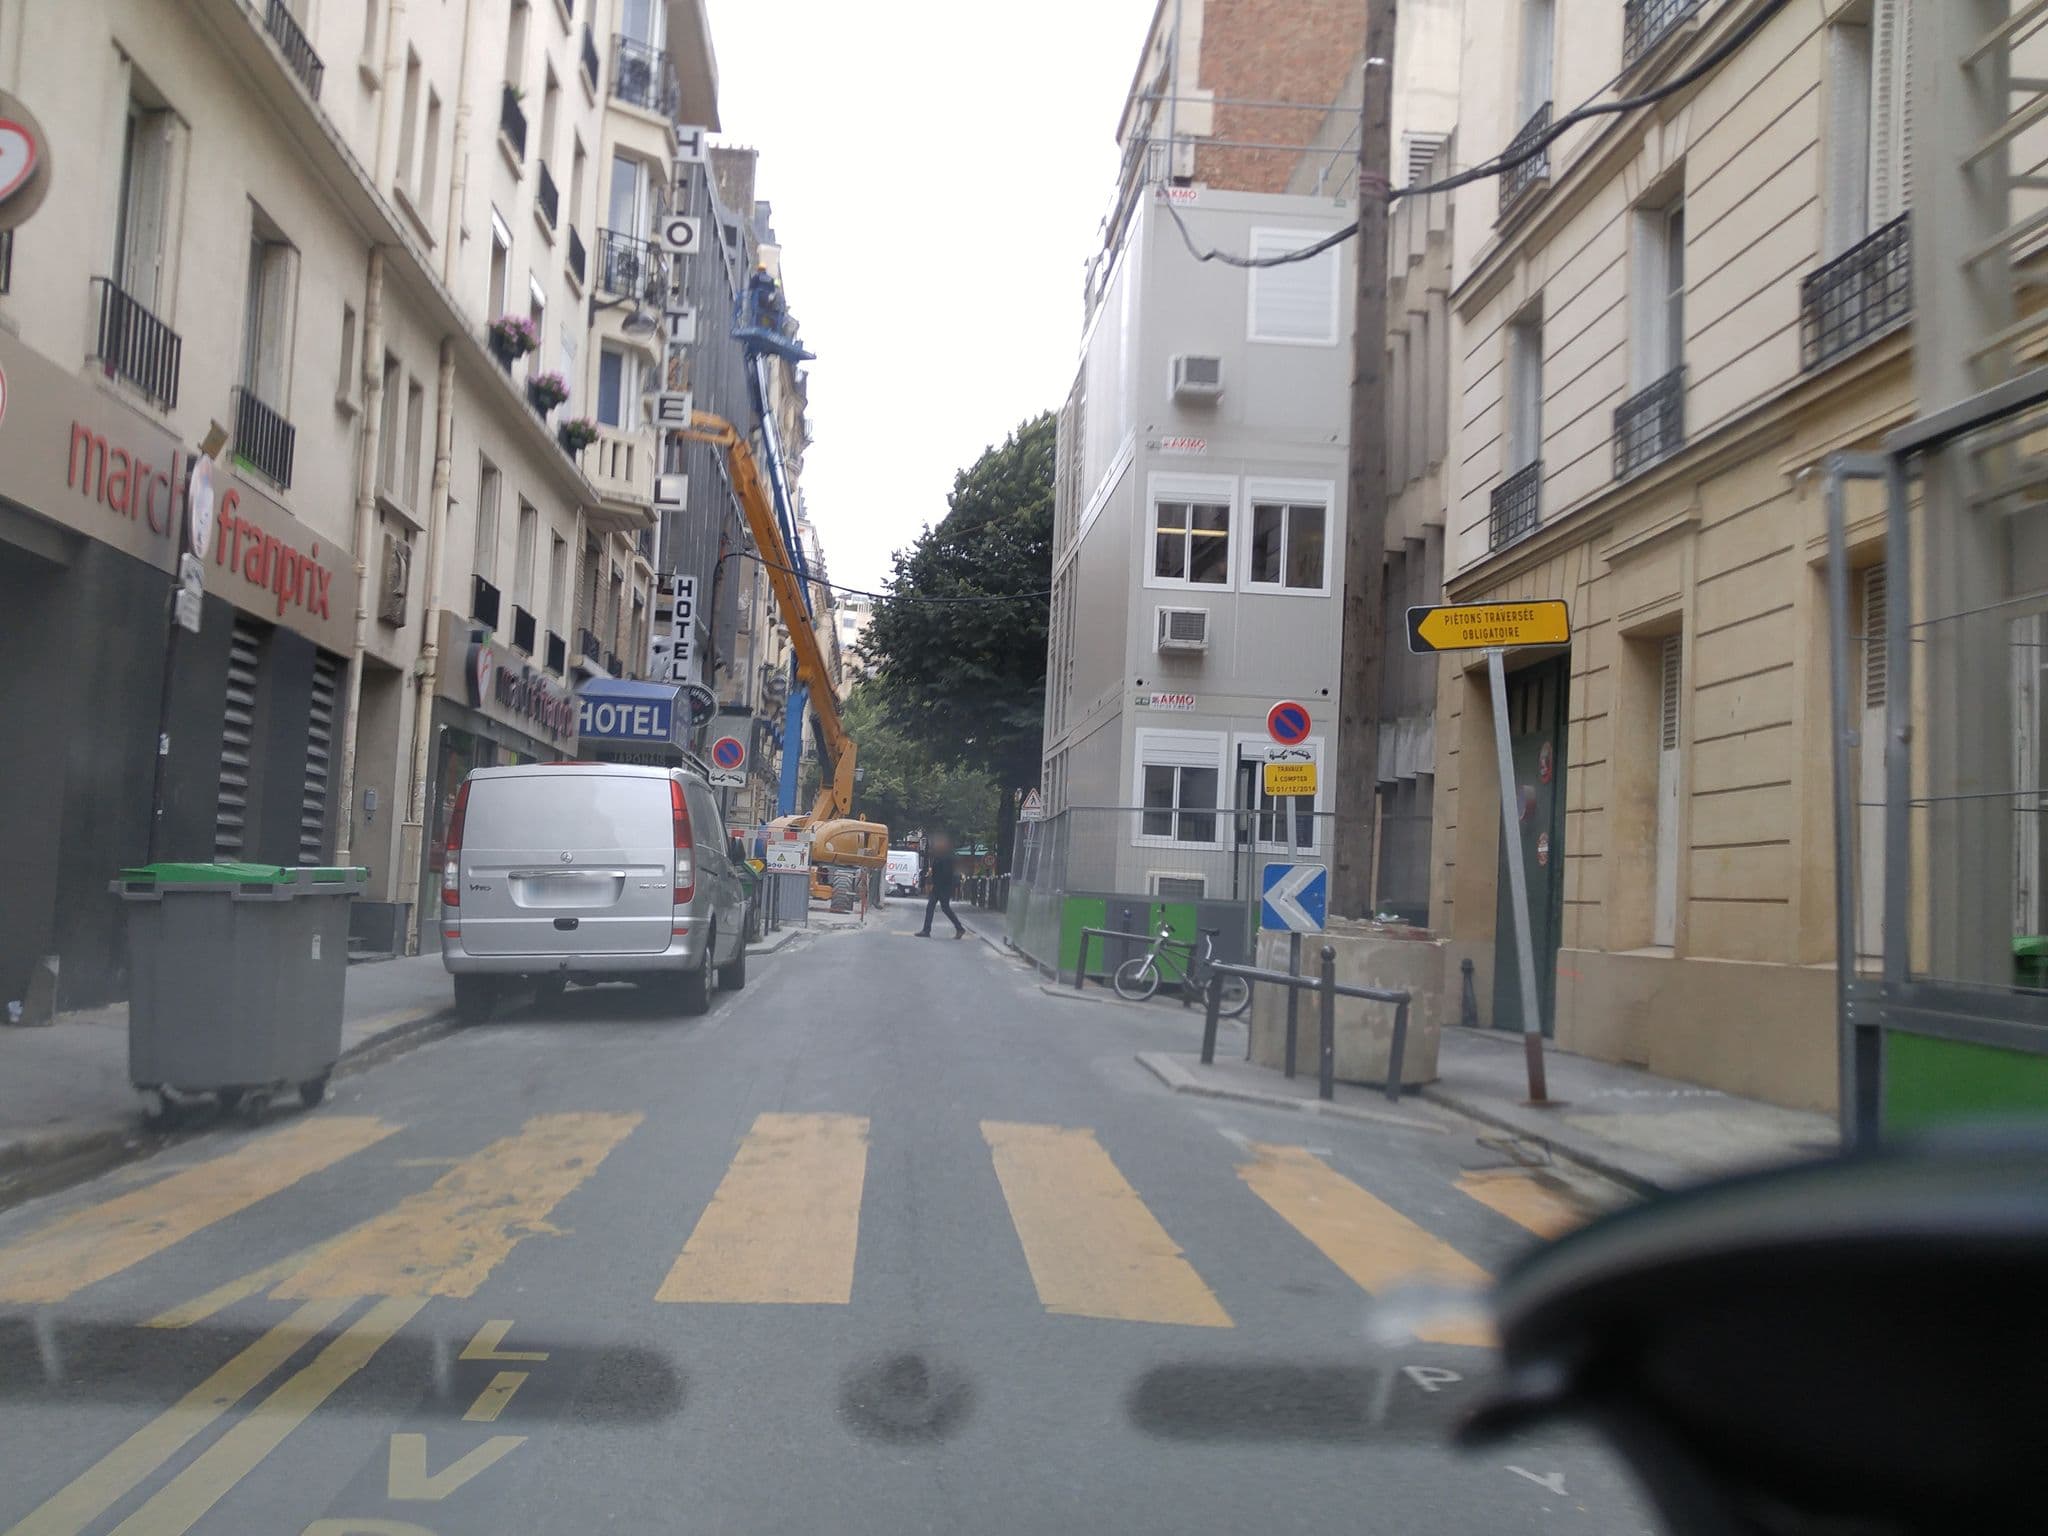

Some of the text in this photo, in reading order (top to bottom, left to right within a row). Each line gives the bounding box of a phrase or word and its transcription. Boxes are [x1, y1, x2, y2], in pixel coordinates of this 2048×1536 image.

[655, 131, 698, 504] HOTEL
[68, 420, 185, 539] march
[216, 487, 333, 621] franprix
[672, 579, 693, 681] HOTEL
[1462, 626, 1520, 641] OBLIGATOIRE
[1485, 608, 1534, 623] TRAVERSÉE
[578, 702, 667, 737] HOTEL
